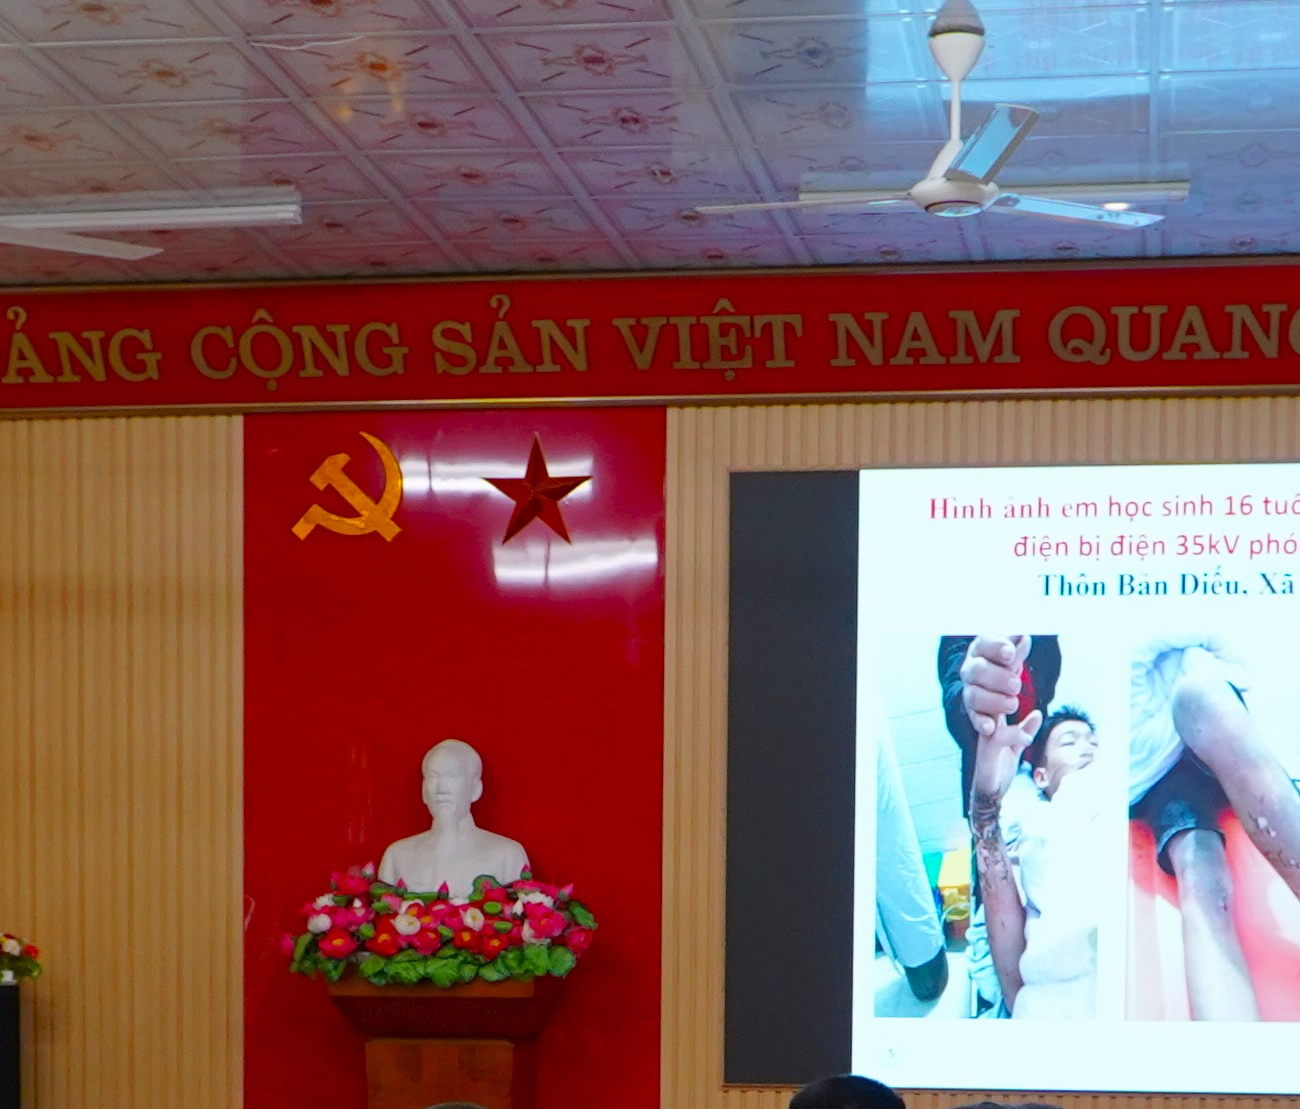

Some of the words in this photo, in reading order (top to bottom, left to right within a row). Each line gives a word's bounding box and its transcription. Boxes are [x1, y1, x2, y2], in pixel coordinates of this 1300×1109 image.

[191, 308, 409, 391] CỘNG
[432, 294, 590, 375] SẢN
[612, 298, 803, 382] VIỆT
[828, 309, 1021, 367] NAM
[930, 496, 992, 519] Hình
[1061, 501, 1098, 518] em
[1108, 495, 1152, 521] học
[1161, 494, 1213, 517] sinh
[1224, 494, 1253, 516] 16
[1013, 534, 1068, 561] điện
[1079, 535, 1100, 561] bị
[1110, 534, 1165, 560] điện
[1176, 534, 1240, 556] 35kV
[1038, 571, 1106, 597] Thôn
[1258, 571, 1294, 595] Xã
